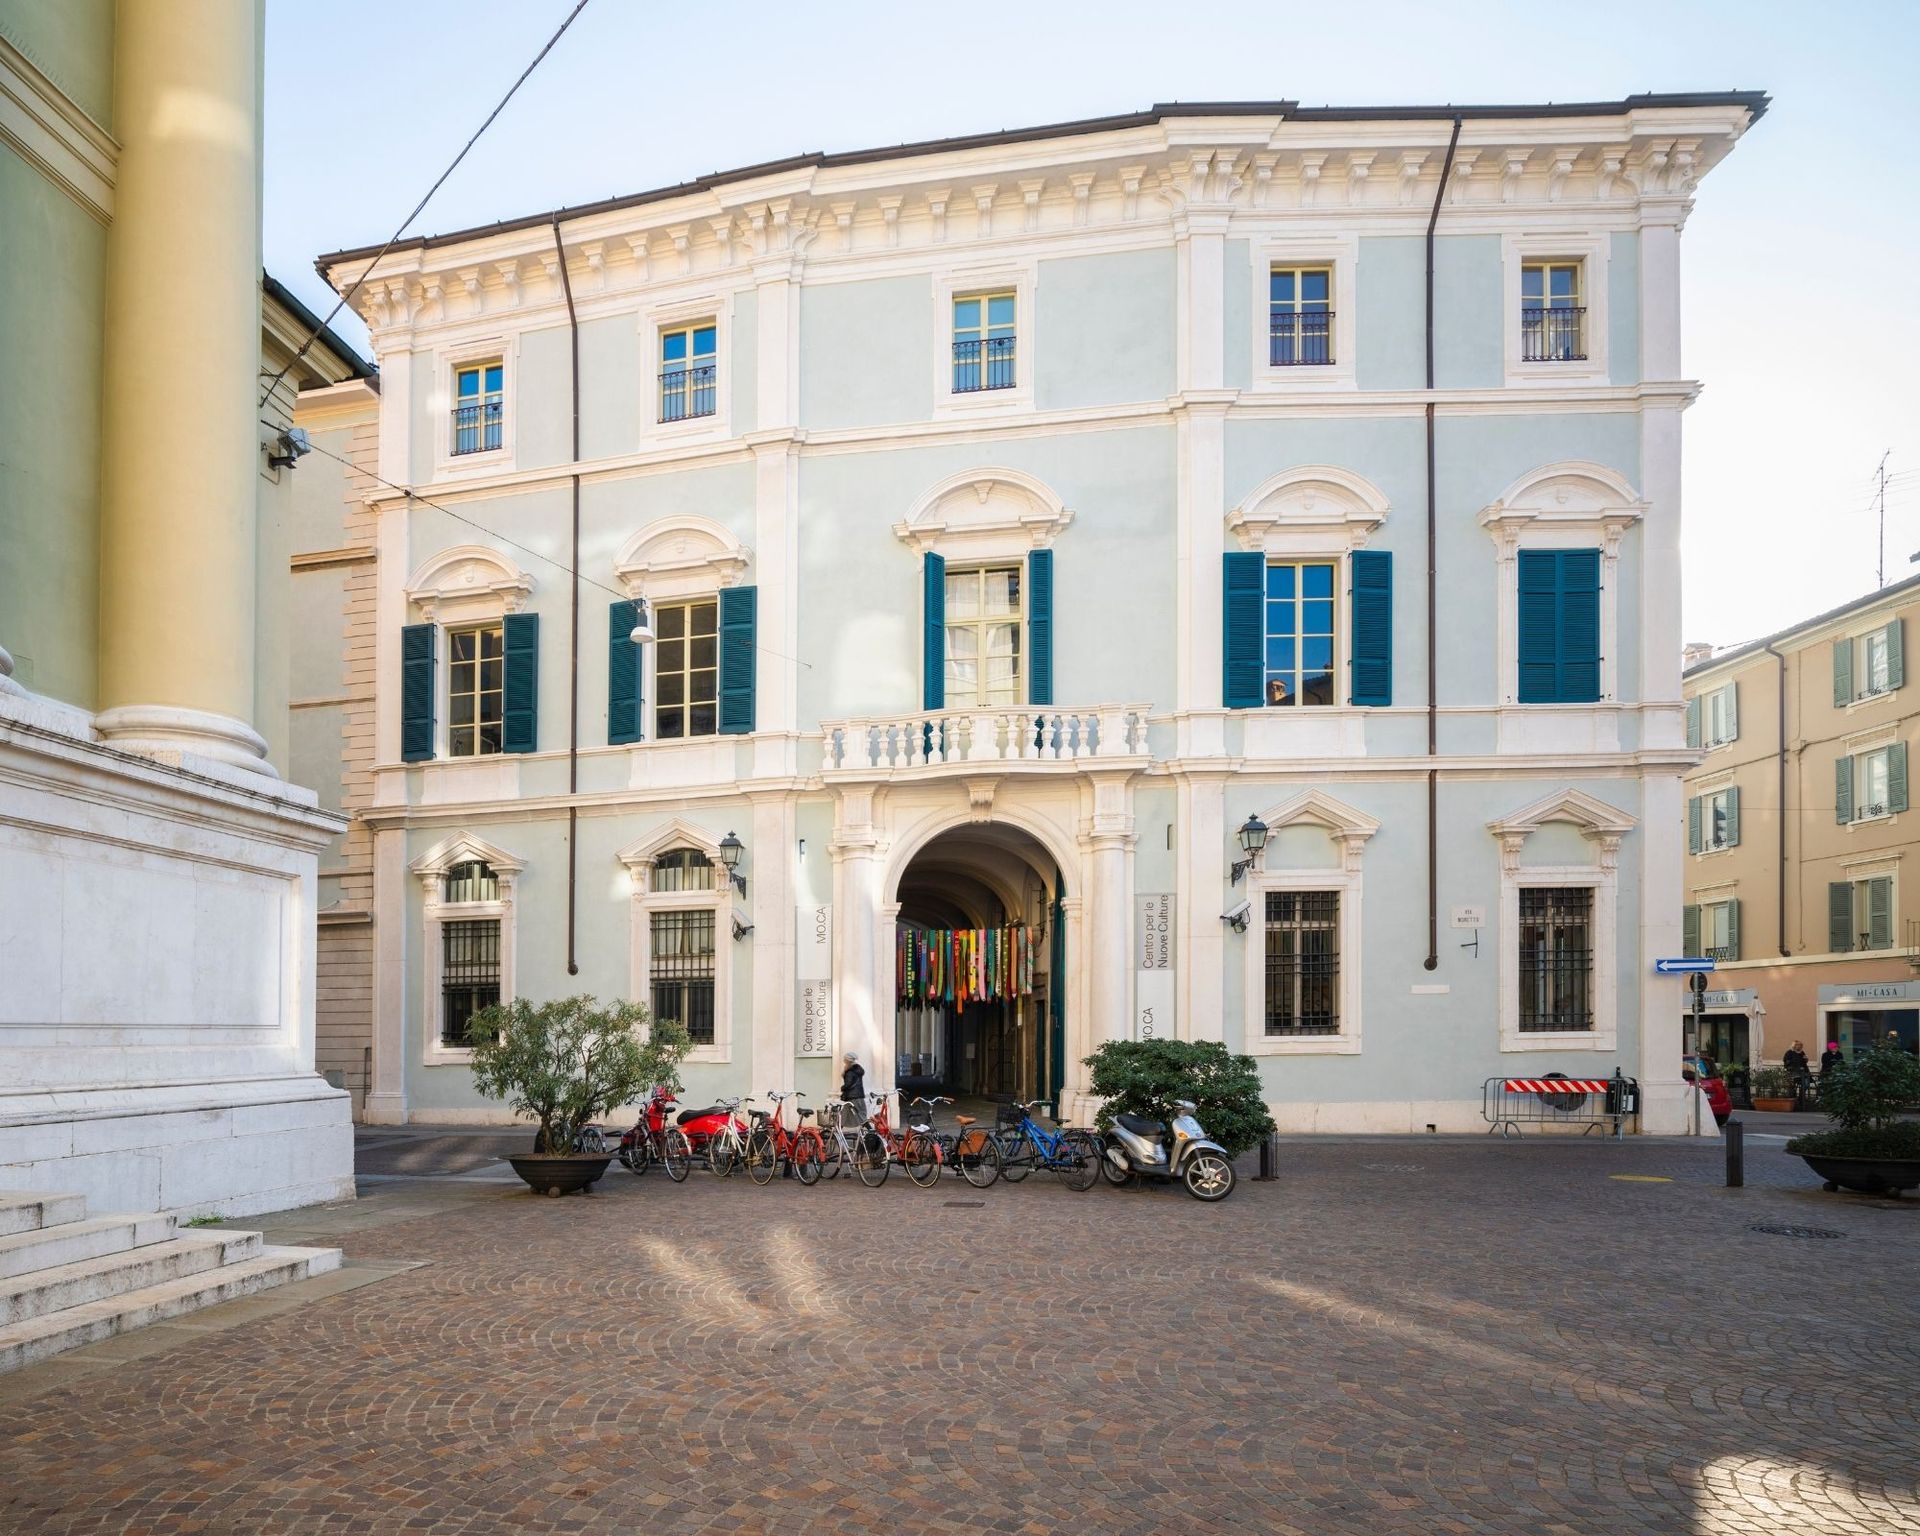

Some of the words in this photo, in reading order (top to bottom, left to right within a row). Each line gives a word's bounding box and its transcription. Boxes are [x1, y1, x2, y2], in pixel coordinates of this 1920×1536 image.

[1144, 901, 1154, 911] le
[1145, 913, 1156, 931] per
[1157, 894, 1168, 933] Culture
[816, 906, 826, 944] MO.CA
[1142, 933, 1154, 969] Centro
[1157, 934, 1168, 968] Nuove
[803, 987, 813, 997] le
[805, 999, 815, 1016] per
[816, 981, 826, 1017] Culture
[803, 1018, 813, 1052] Centro
[816, 1019, 826, 1052] Nuove
